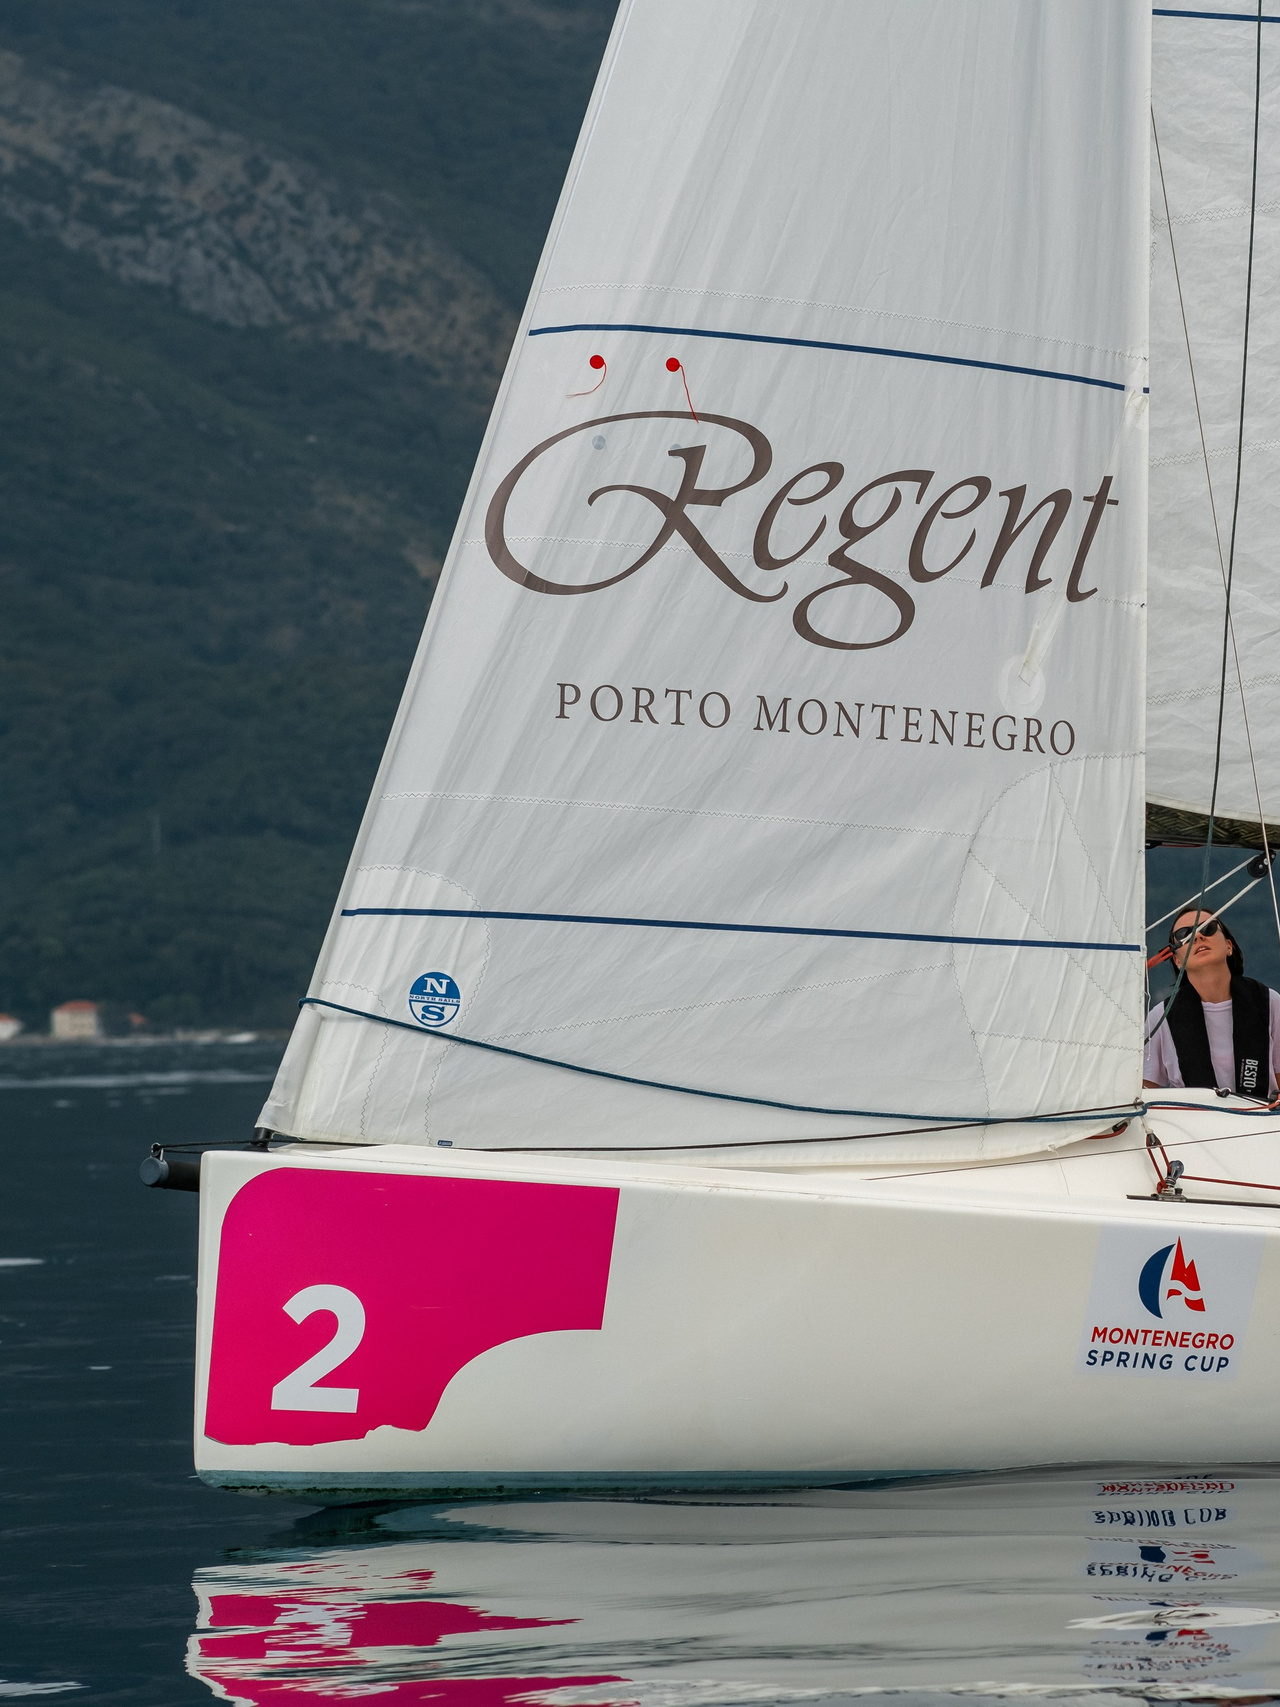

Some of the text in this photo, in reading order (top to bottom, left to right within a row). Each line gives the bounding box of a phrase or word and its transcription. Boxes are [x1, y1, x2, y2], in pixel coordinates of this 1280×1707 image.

[483, 410, 1119, 650] Regent
[555, 682, 1077, 756] PORTO MONTENEGRO
[423, 977, 450, 994] N
[421, 1005, 445, 1021] S
[1244, 1059, 1259, 1088] BESTO
[270, 1283, 366, 1414] 2
[1091, 1326, 1235, 1350] MONTENEGRO
[1086, 1349, 1230, 1373] SPRING CUP
